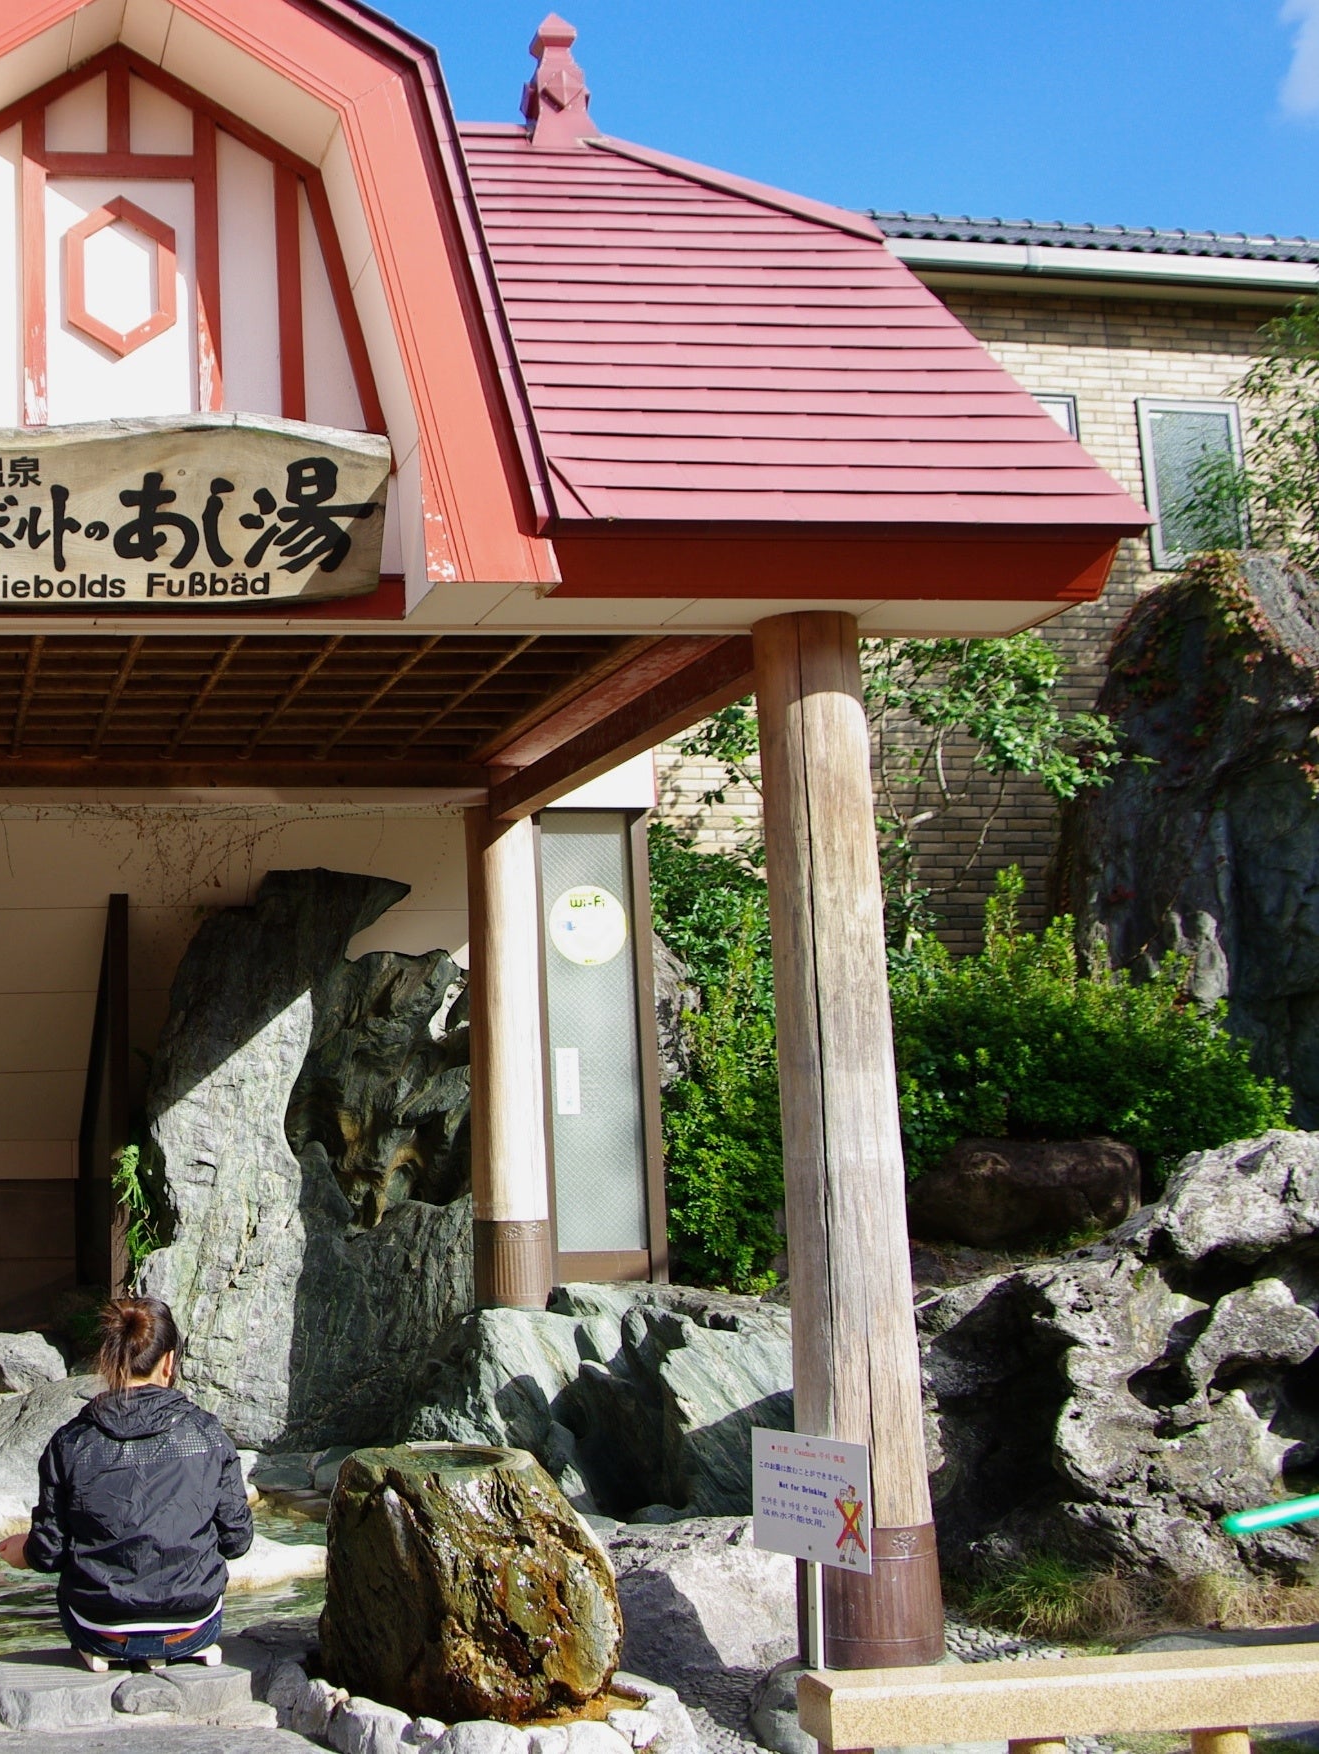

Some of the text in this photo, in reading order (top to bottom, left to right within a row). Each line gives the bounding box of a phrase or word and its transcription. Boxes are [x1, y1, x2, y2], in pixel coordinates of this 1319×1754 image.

[794, 1448, 816, 1458] Caution
[779, 1481, 788, 1489] Not
[791, 1483, 799, 1491] for
